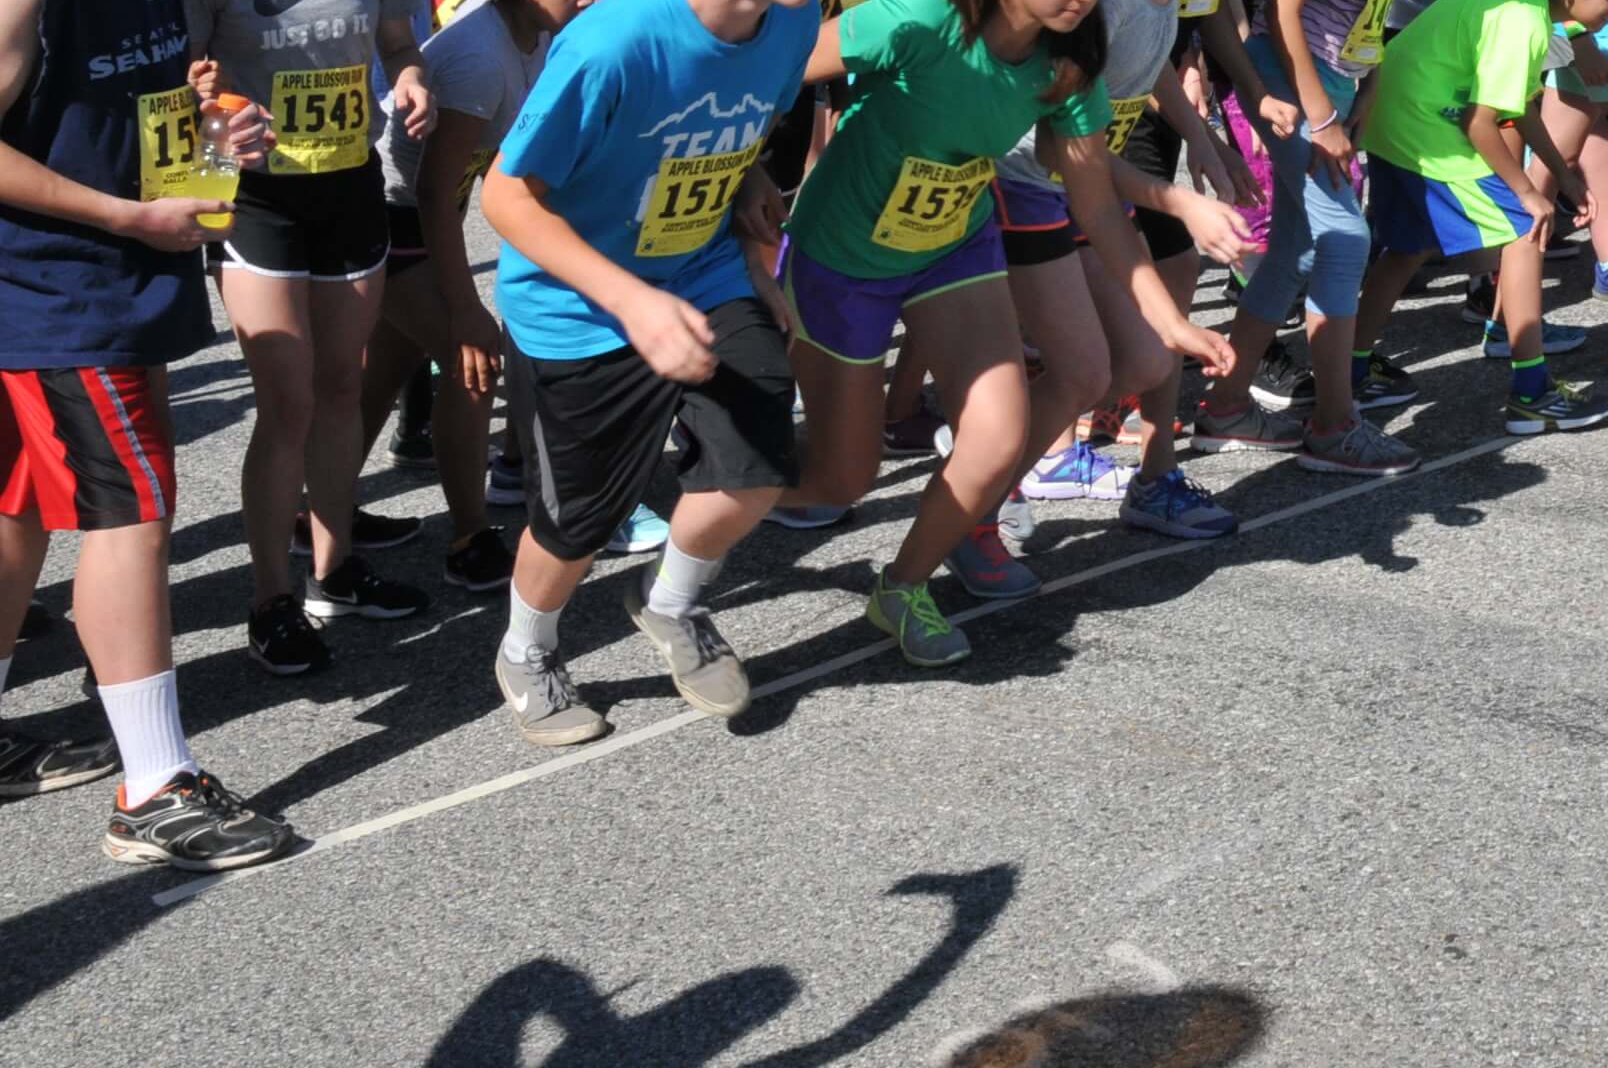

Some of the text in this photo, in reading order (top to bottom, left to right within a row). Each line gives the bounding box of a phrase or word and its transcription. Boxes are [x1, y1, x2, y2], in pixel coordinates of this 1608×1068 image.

[261, 23, 310, 50] JUST
[352, 13, 369, 35] IT
[281, 73, 312, 90] APPLE
[313, 68, 351, 88] BLOSSOM
[149, 94, 178, 115] APPLE
[281, 89, 364, 132] 1543
[668, 160, 702, 176] APPLE
[702, 151, 744, 174] BLOSSOM
[911, 161, 942, 181] APPLE
